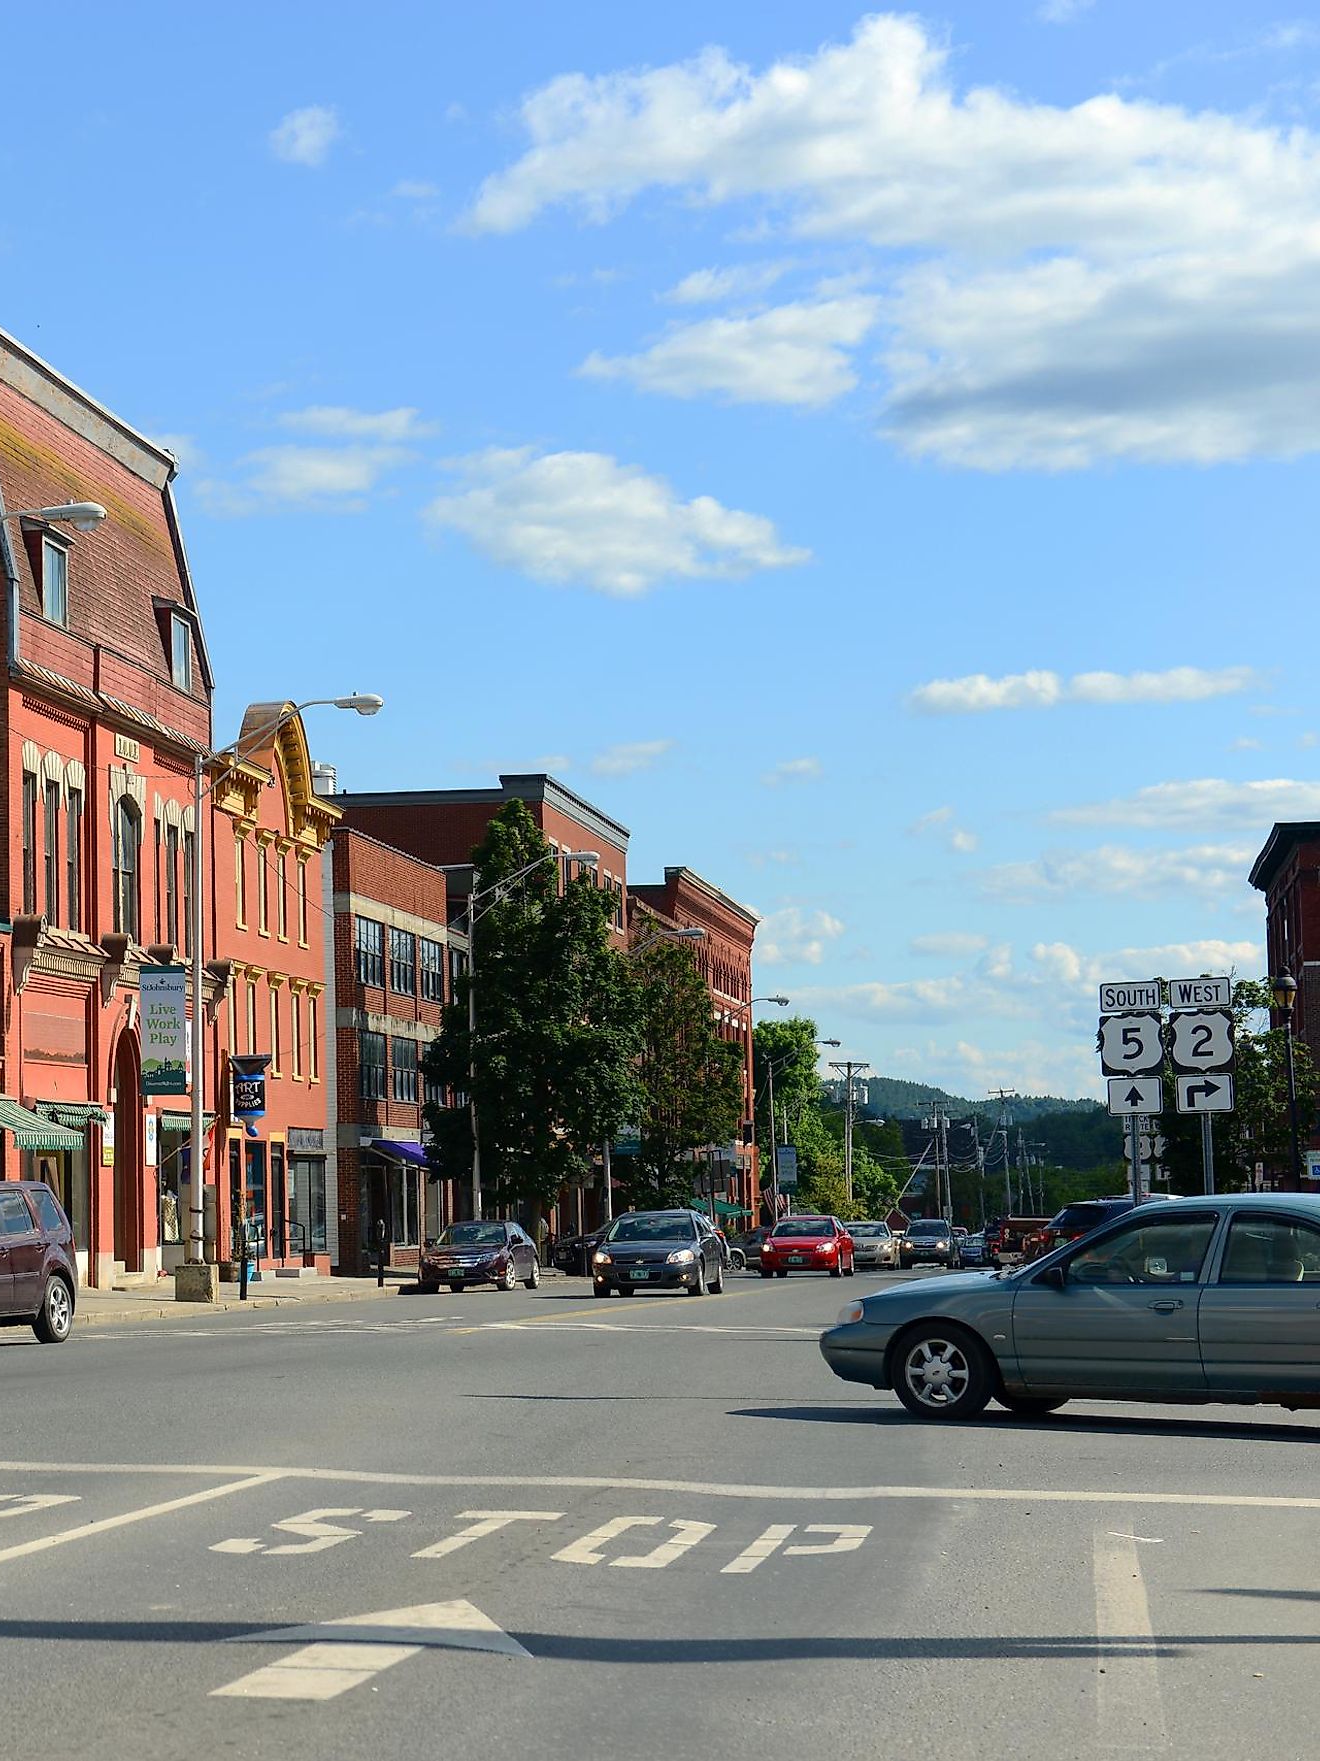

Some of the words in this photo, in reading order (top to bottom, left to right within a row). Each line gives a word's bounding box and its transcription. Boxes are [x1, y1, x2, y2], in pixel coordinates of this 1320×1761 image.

[1105, 988, 1156, 1007] SOUTH
[1178, 984, 1221, 1003] WEST
[150, 1003, 176, 1015] Live
[146, 1018, 181, 1030] Work
[150, 1032, 177, 1046] Play
[1122, 1027, 1144, 1060] 5
[1191, 1024, 1214, 1057] 2
[235, 1081, 261, 1095] ART
[208, 1507, 873, 1573] STOP
